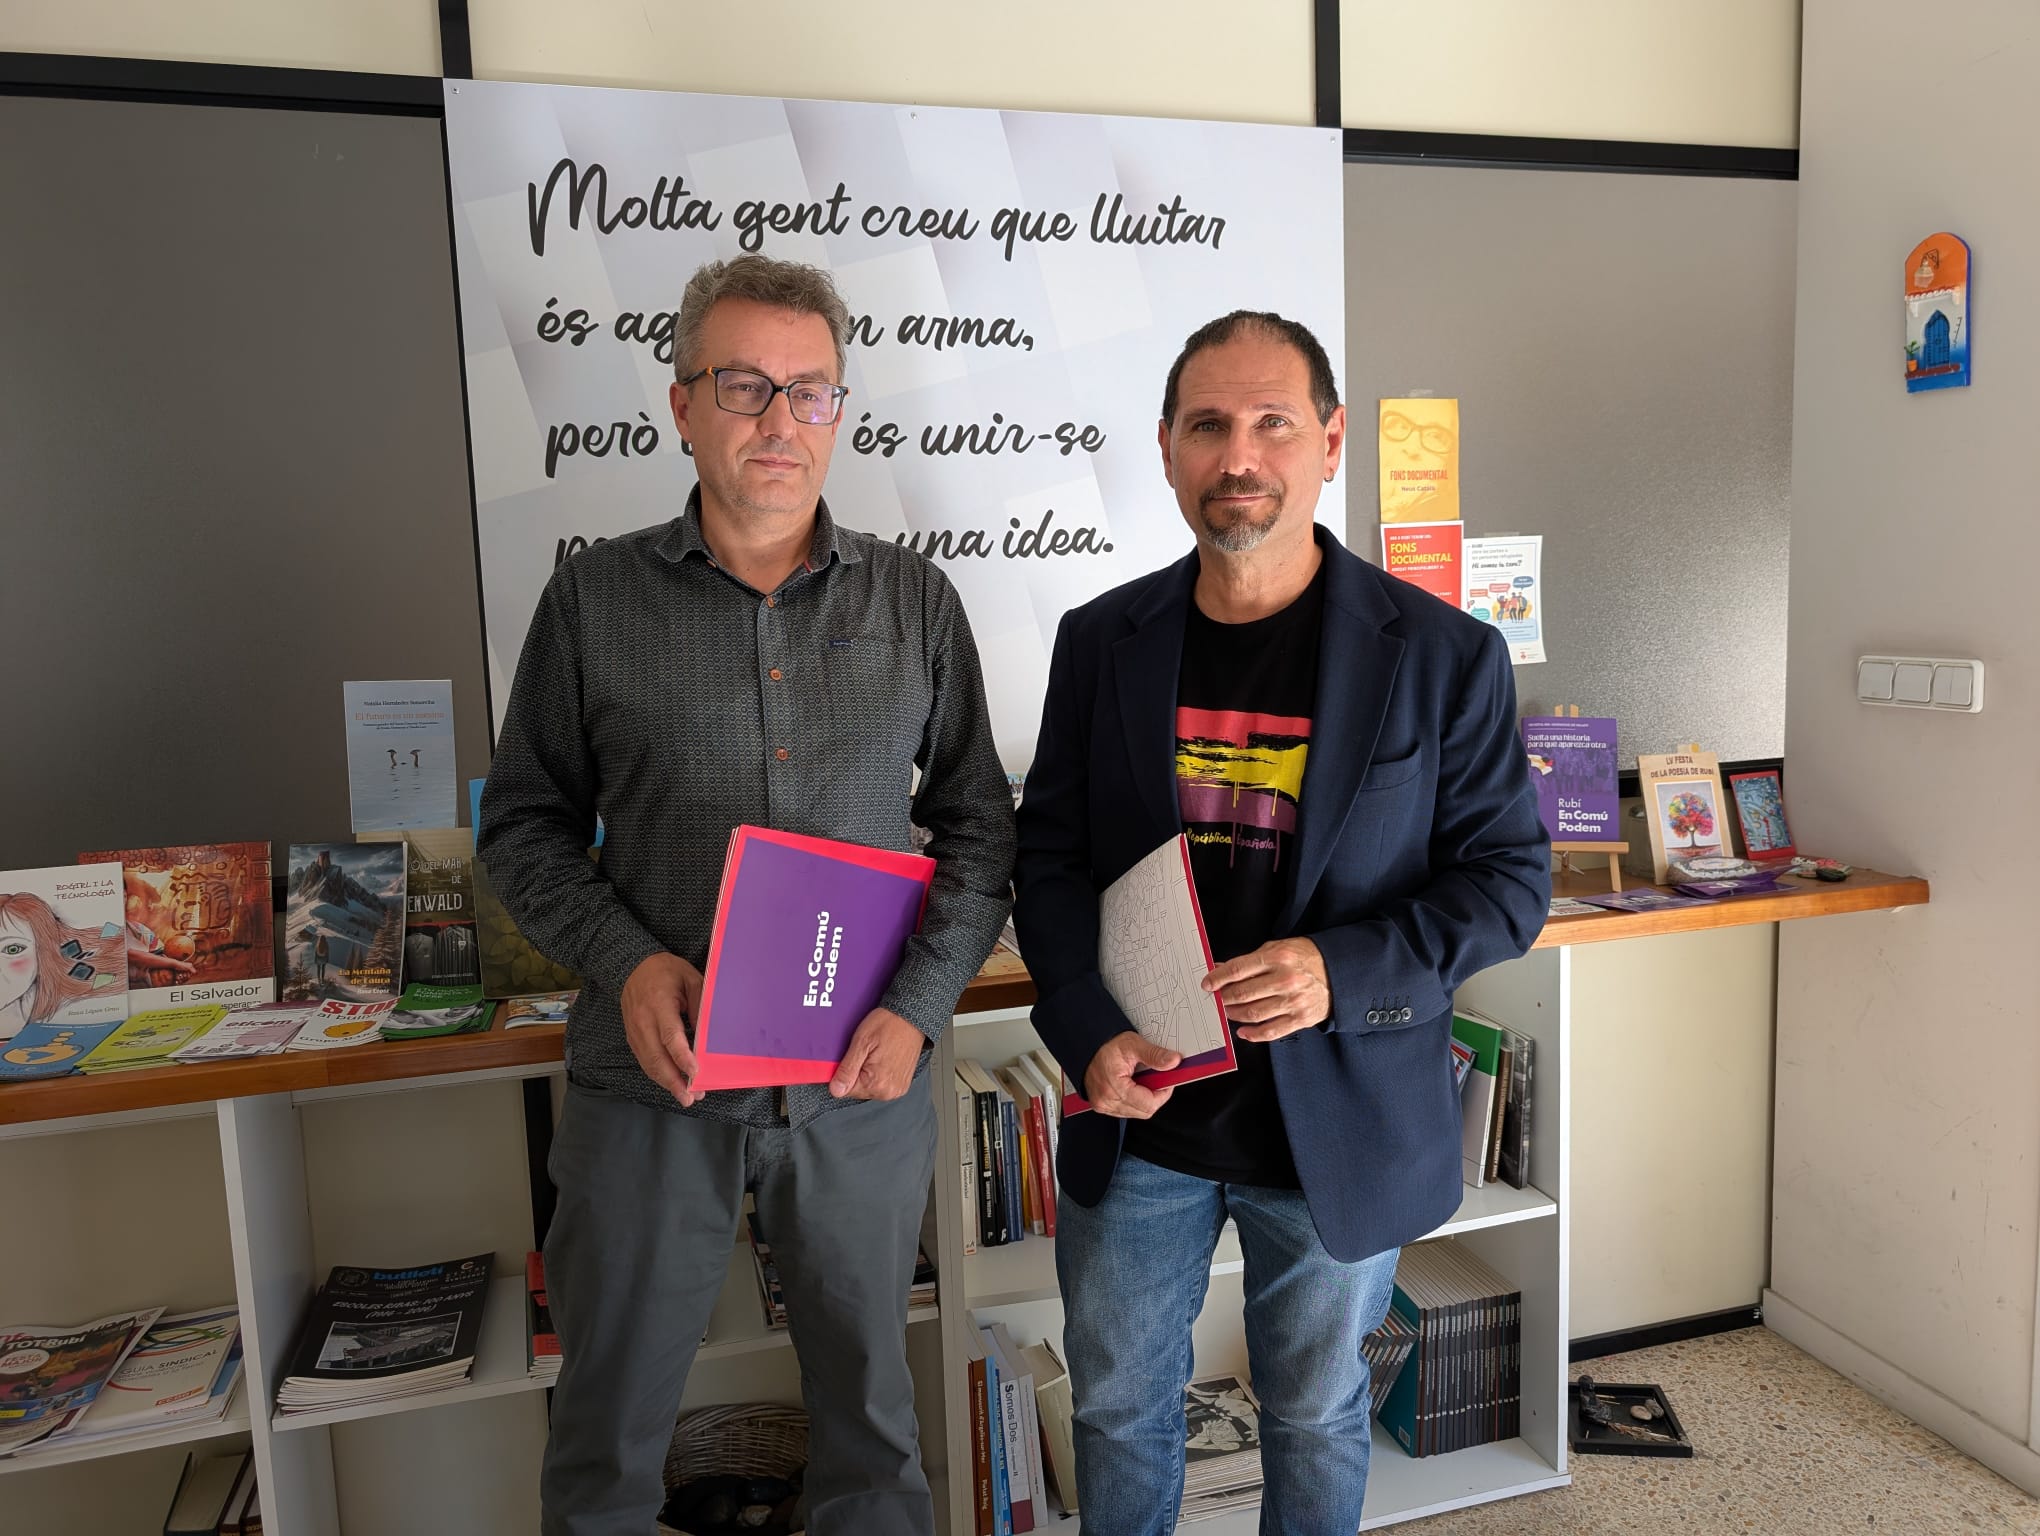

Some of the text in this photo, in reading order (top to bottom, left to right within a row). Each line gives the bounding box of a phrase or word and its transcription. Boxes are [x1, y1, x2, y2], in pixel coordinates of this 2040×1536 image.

[528, 158, 1226, 262] Molta gent creu que lluitar
[537, 297, 600, 346] és
[897, 314, 1034, 351] arma,
[545, 411, 1107, 478] però és unir-se
[1002, 509, 1114, 559] idea.
[1390, 542, 1417, 553] FONS
[1391, 553, 1453, 565] DOCUMENTAL
[1675, 756, 1693, 764] FESTA
[1690, 767, 1699, 775] DE
[1558, 797, 1582, 808] Rubí
[1558, 810, 1608, 821] En Comú
[1186, 827, 1233, 846] República
[1558, 822, 1601, 833] Podem
[101, 879, 114, 887] LA
[451, 875, 462, 884] DE
[54, 888, 116, 901] TECNOLOGIA
[803, 911, 831, 1007] En Comú
[819, 926, 844, 1007] Podem
[170, 985, 262, 1003] El Salvador
[121, 1365, 155, 1375] GUIA
[159, 1349, 218, 1368] SINDICAL
[1004, 1384, 1017, 1420] Somos
[1008, 1422, 1018, 1443] Dos
